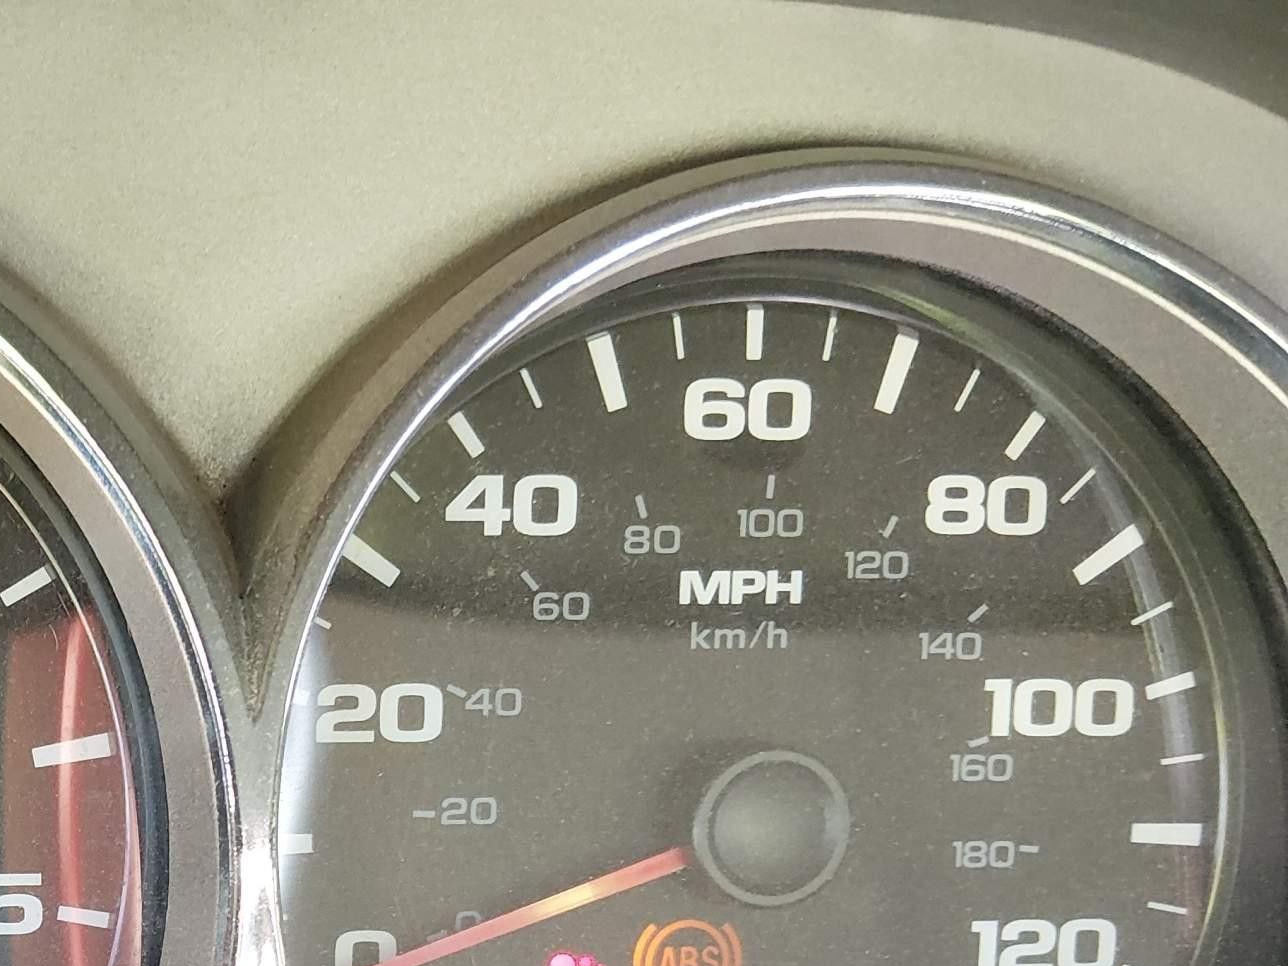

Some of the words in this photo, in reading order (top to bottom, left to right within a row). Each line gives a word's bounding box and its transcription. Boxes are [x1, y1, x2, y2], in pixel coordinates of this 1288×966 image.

[683, 378, 812, 441] 60
[445, 474, 578, 537] 40
[925, 474, 1047, 536] 80
[736, 509, 804, 539] 100
[623, 525, 681, 555] 80
[844, 550, 910, 580] 120
[678, 570, 803, 606] MPH
[532, 592, 590, 622] 60
[690, 621, 788, 650] km/h
[919, 632, 982, 661] 140
[315, 683, 444, 744] 20
[464, 688, 523, 717] 40
[983, 678, 1134, 737] 100
[950, 753, 1014, 782] 160
[440, 797, 498, 826] 20
[952, 840, 1014, 869] 180
